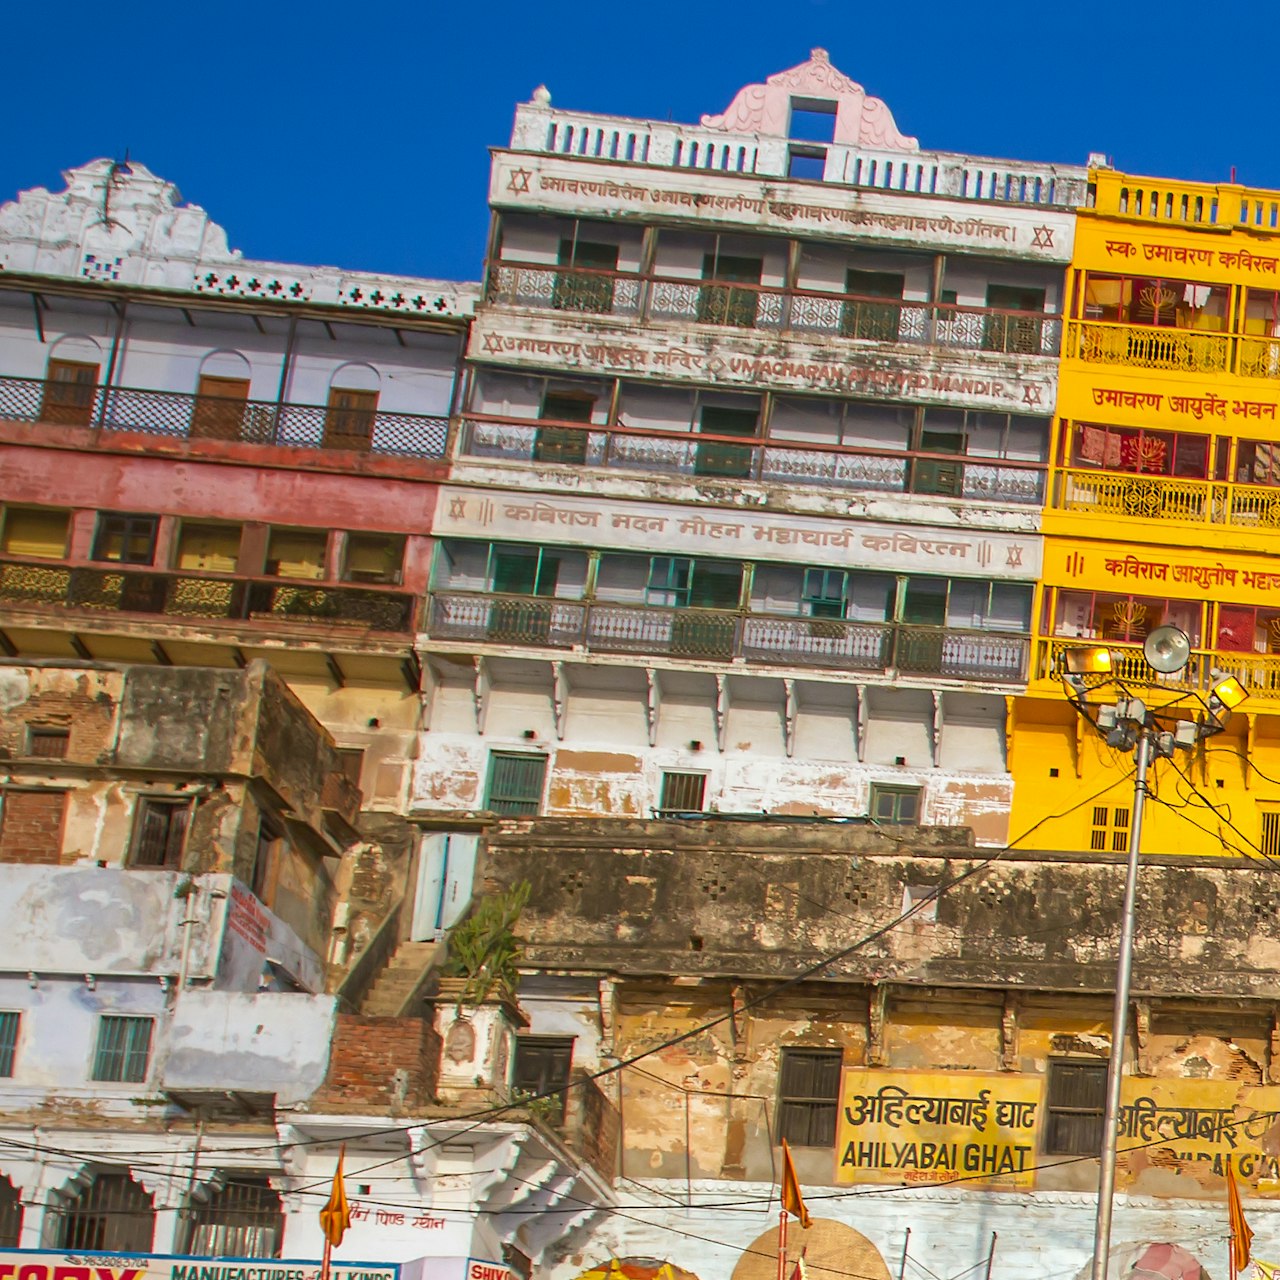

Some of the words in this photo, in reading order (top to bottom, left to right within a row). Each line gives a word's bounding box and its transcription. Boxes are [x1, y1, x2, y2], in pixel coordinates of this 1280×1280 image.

[1142, 243, 1215, 266] उमाचरण
[1219, 249, 1279, 273] कविरत्न
[730, 358, 843, 380] UMACHARAN
[1092, 388, 1163, 411] उमाचरण
[1168, 393, 1227, 420] आयुर्वेद
[1232, 400, 1278, 420] भवन
[503, 501, 601, 527] कविराज
[611, 513, 669, 532] मदन
[678, 515, 744, 539] मोहन
[861, 531, 971, 558] कविरत्न
[1105, 555, 1169, 581] कविराज
[1172, 563, 1238, 589] आशुतोष
[845, 1085, 991, 1131] अहिल्याबाई
[996, 1101, 1036, 1128] घाट
[841, 1141, 957, 1170] AHILYABAI
[964, 1144, 1031, 1173] GHAT
